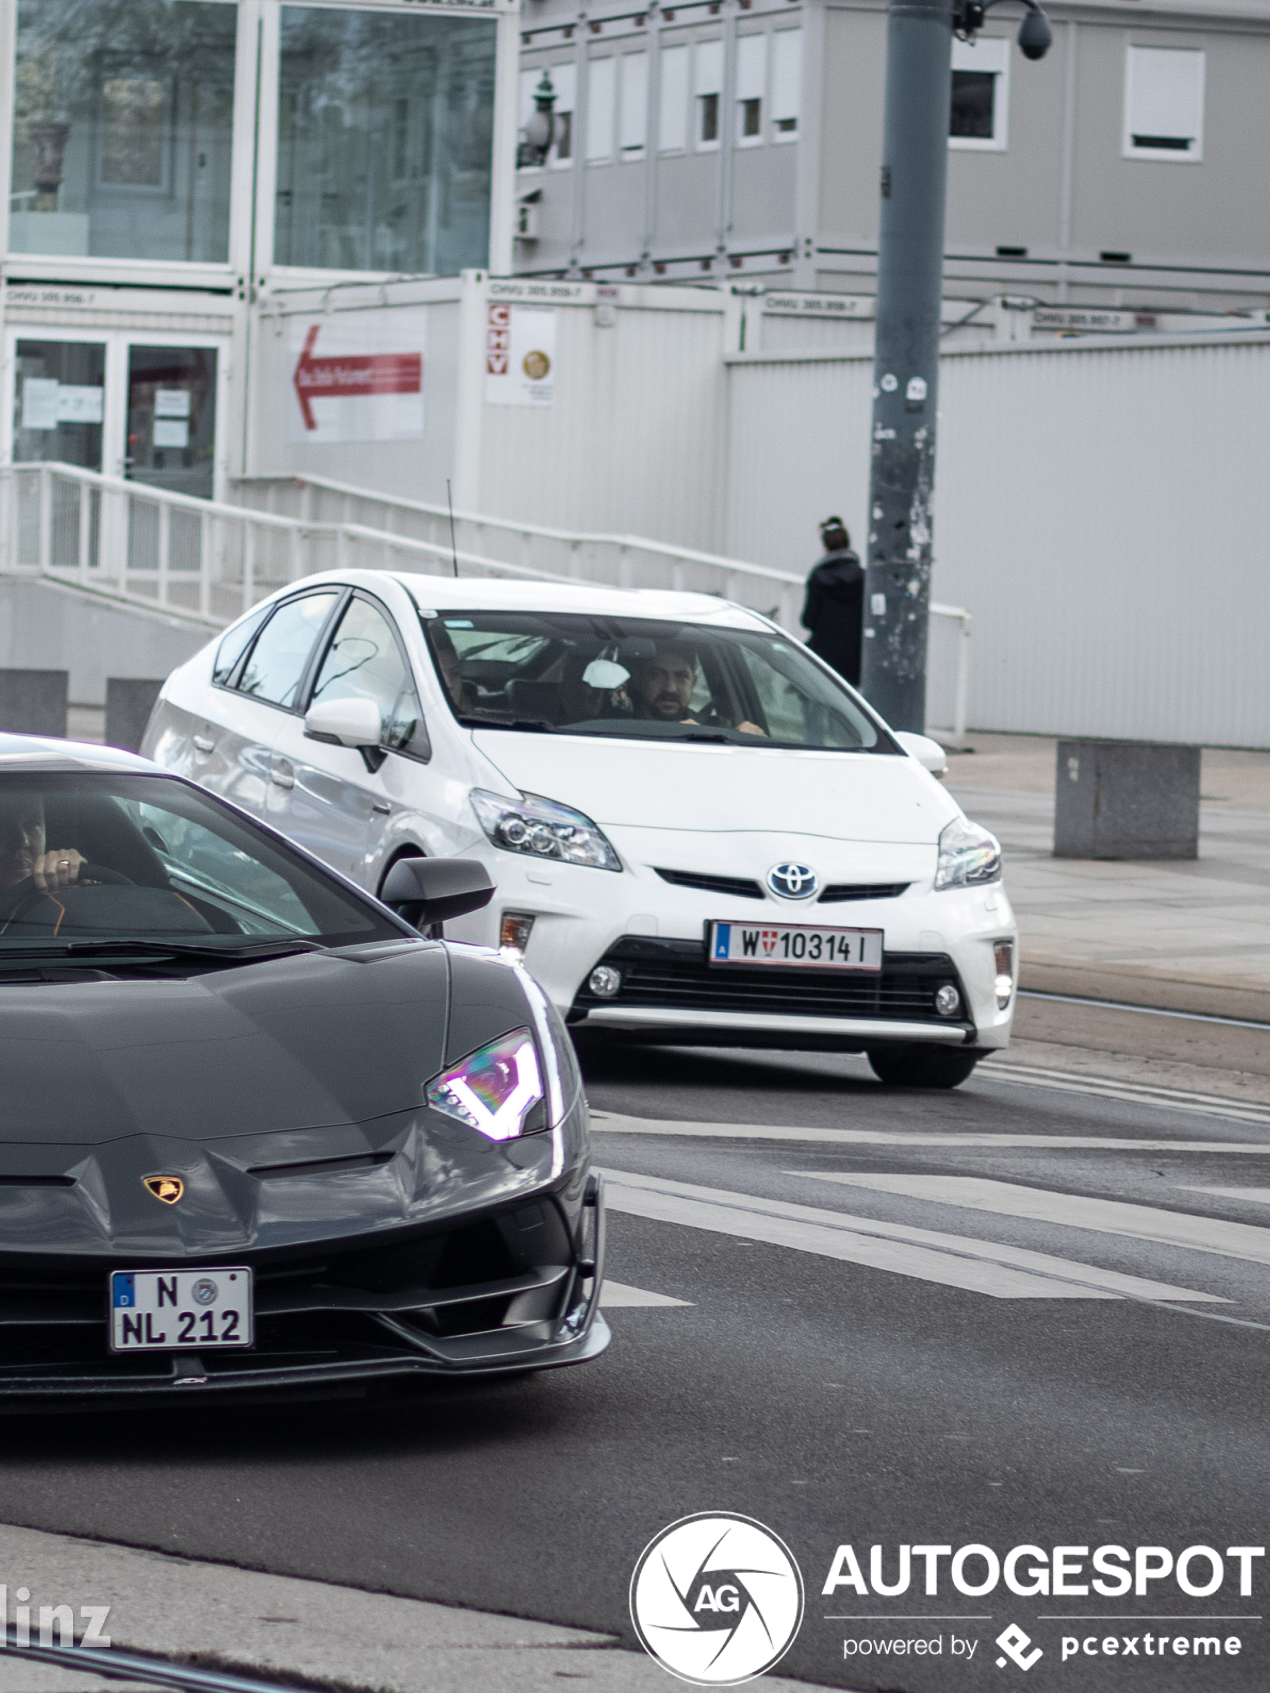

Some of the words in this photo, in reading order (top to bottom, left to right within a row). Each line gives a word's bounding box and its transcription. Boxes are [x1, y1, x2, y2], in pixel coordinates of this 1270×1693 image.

[742, 930, 760, 956] W
[780, 932, 851, 961] 10314
[120, 1295, 129, 1306] D
[157, 1276, 178, 1307] N
[122, 1312, 166, 1344] NL
[178, 1310, 240, 1343] 212
